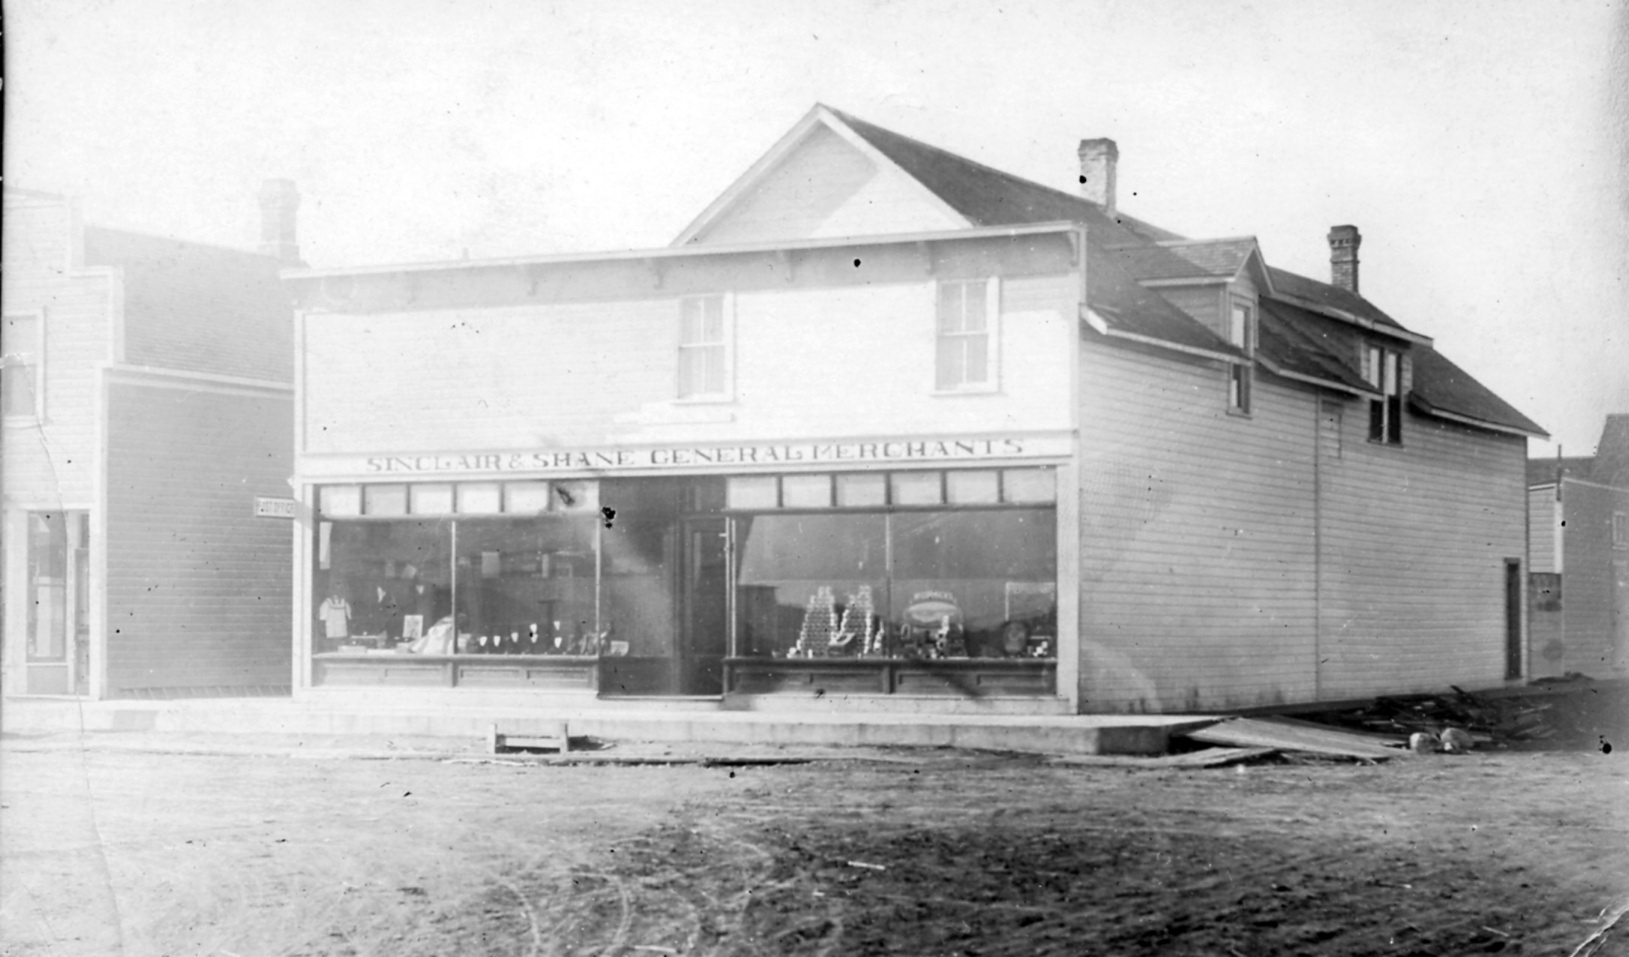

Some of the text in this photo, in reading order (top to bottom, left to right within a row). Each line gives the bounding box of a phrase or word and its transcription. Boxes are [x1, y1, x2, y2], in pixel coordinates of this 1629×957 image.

[366, 438, 1024, 472] SINCLAIR & SHANE GENERAL MERCHANTS
